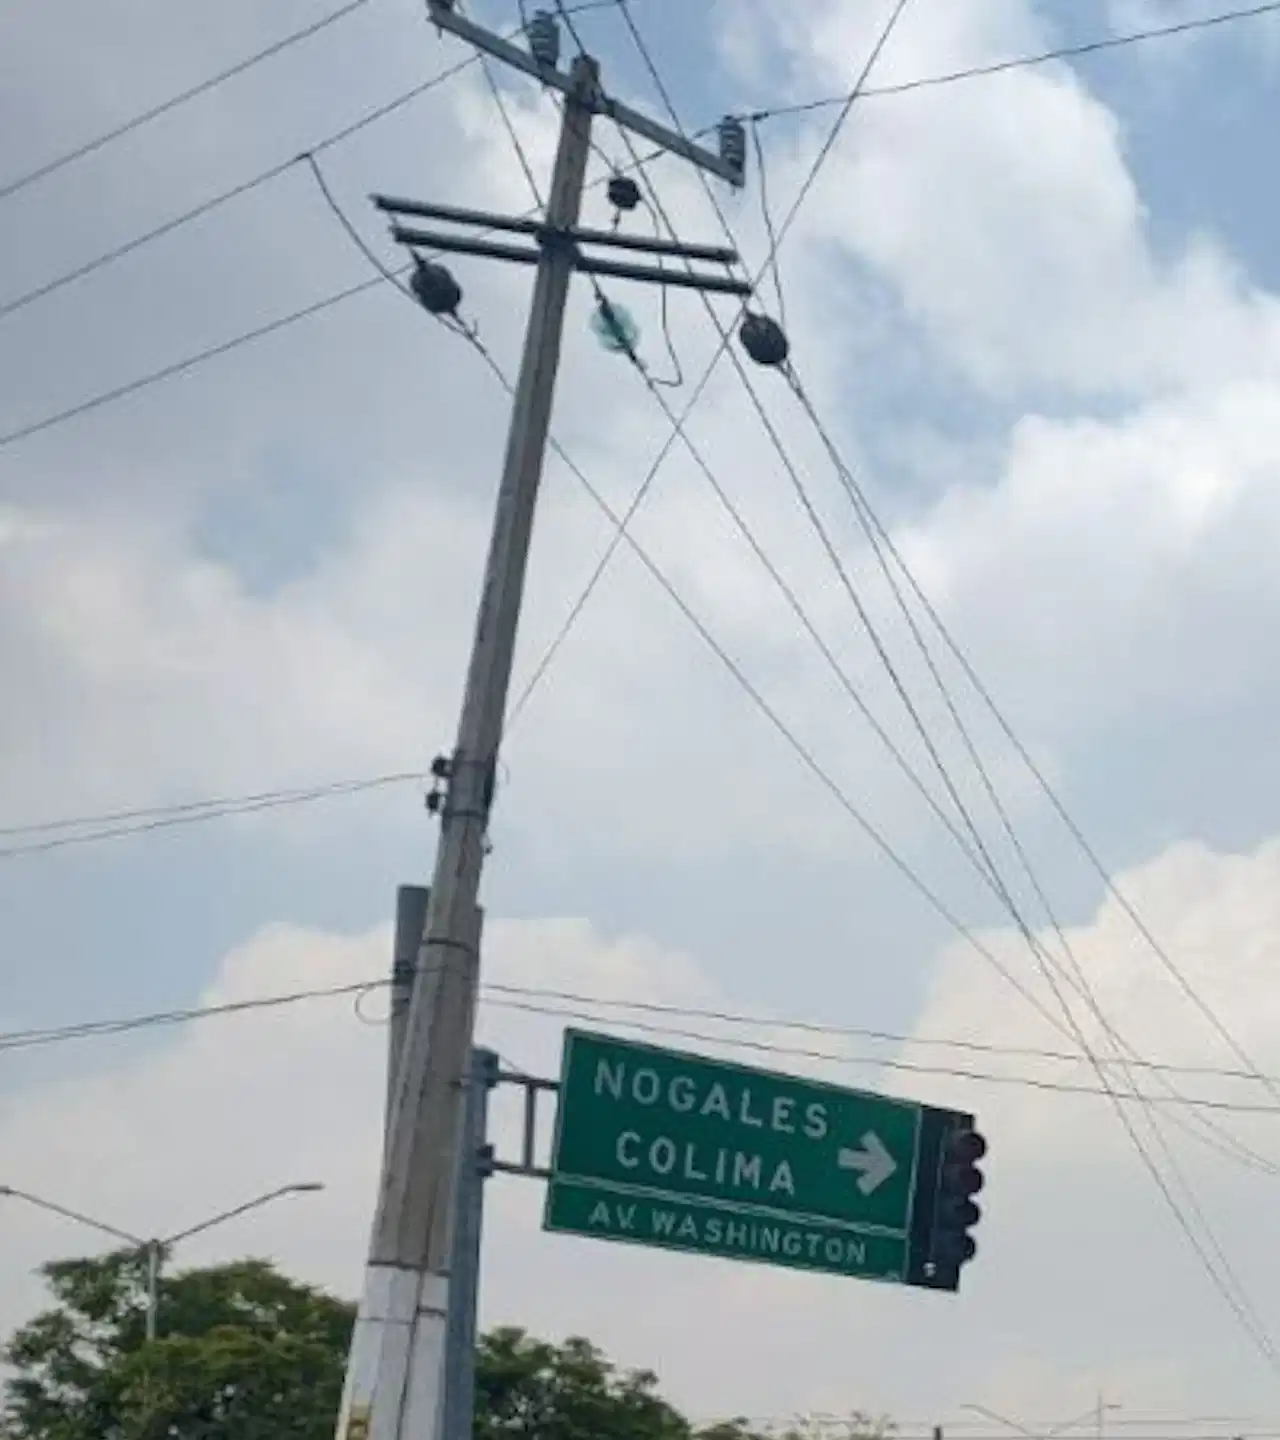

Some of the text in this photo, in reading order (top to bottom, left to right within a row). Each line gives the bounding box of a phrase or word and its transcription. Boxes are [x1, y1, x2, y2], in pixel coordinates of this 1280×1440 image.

[594, 1058, 829, 1138] NOGALES
[615, 1130, 796, 1196] COLIMA
[651, 1207, 866, 1265] WASHINGTON
